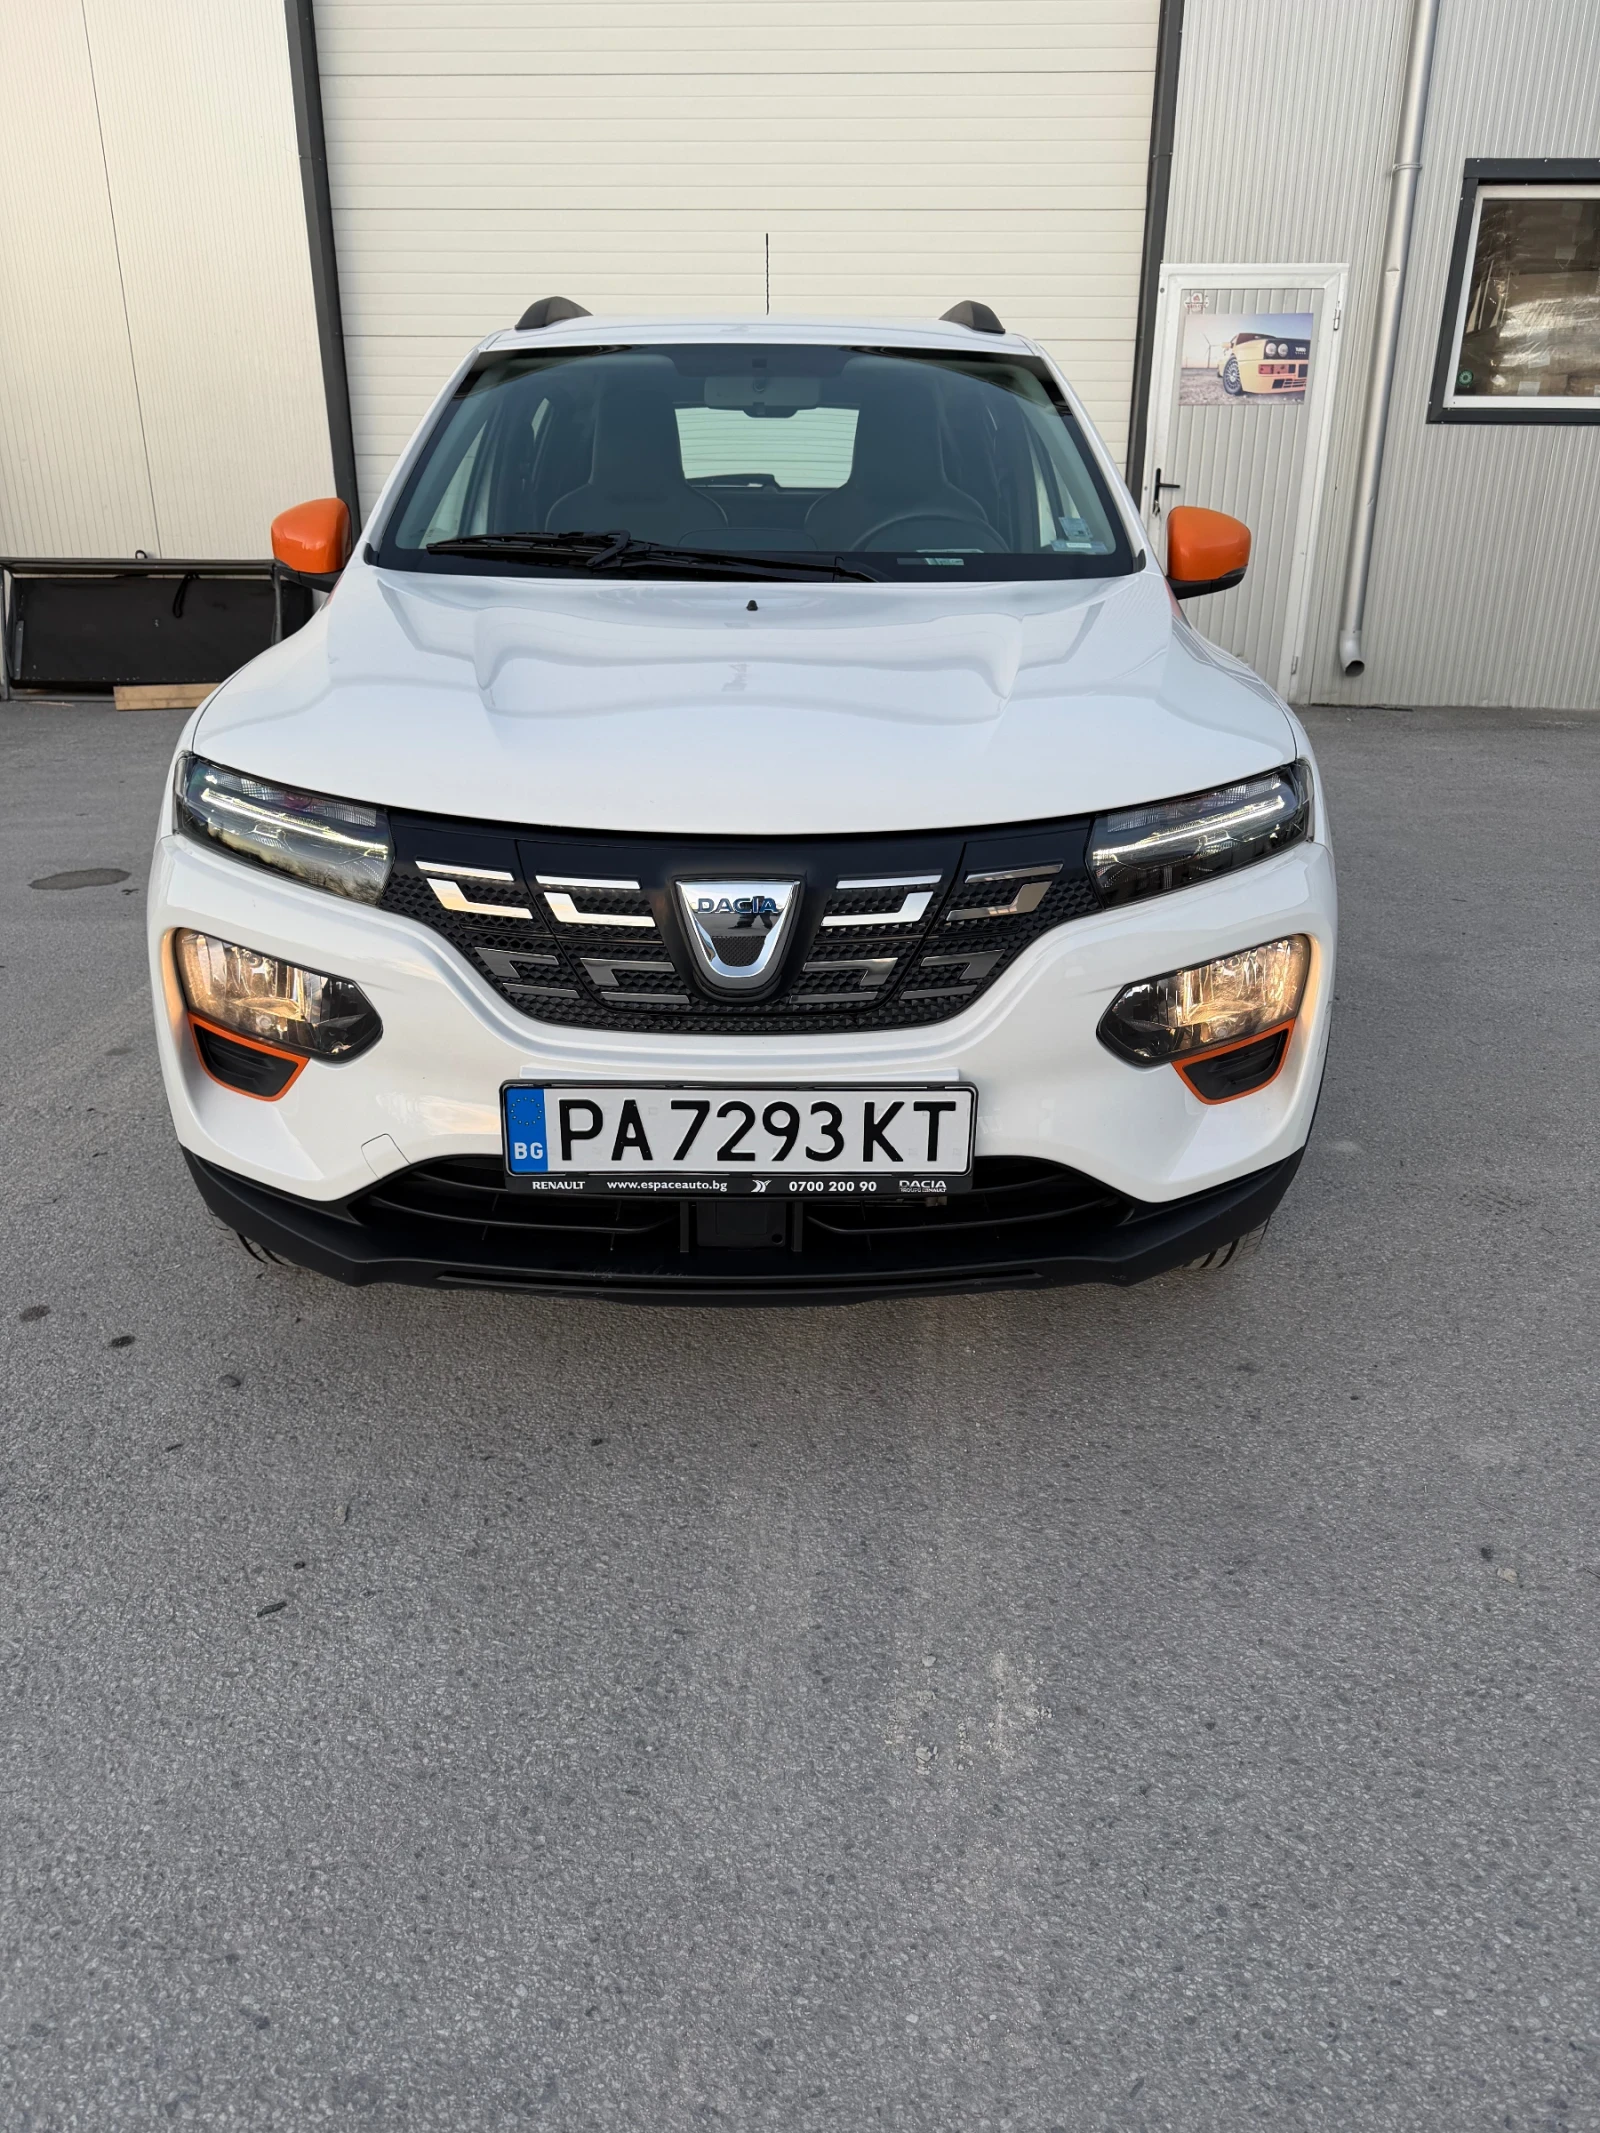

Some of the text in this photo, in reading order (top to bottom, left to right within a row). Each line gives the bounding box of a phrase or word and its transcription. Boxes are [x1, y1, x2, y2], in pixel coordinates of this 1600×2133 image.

[698, 898, 778, 913] DACIA
[514, 1142, 543, 1160] BG
[532, 1181, 586, 1190] RENAULT
[607, 1180, 728, 1192] www.espaceauto.bg
[788, 1181, 877, 1192] 0700 200 90
[899, 1180, 947, 1189] DACIA
